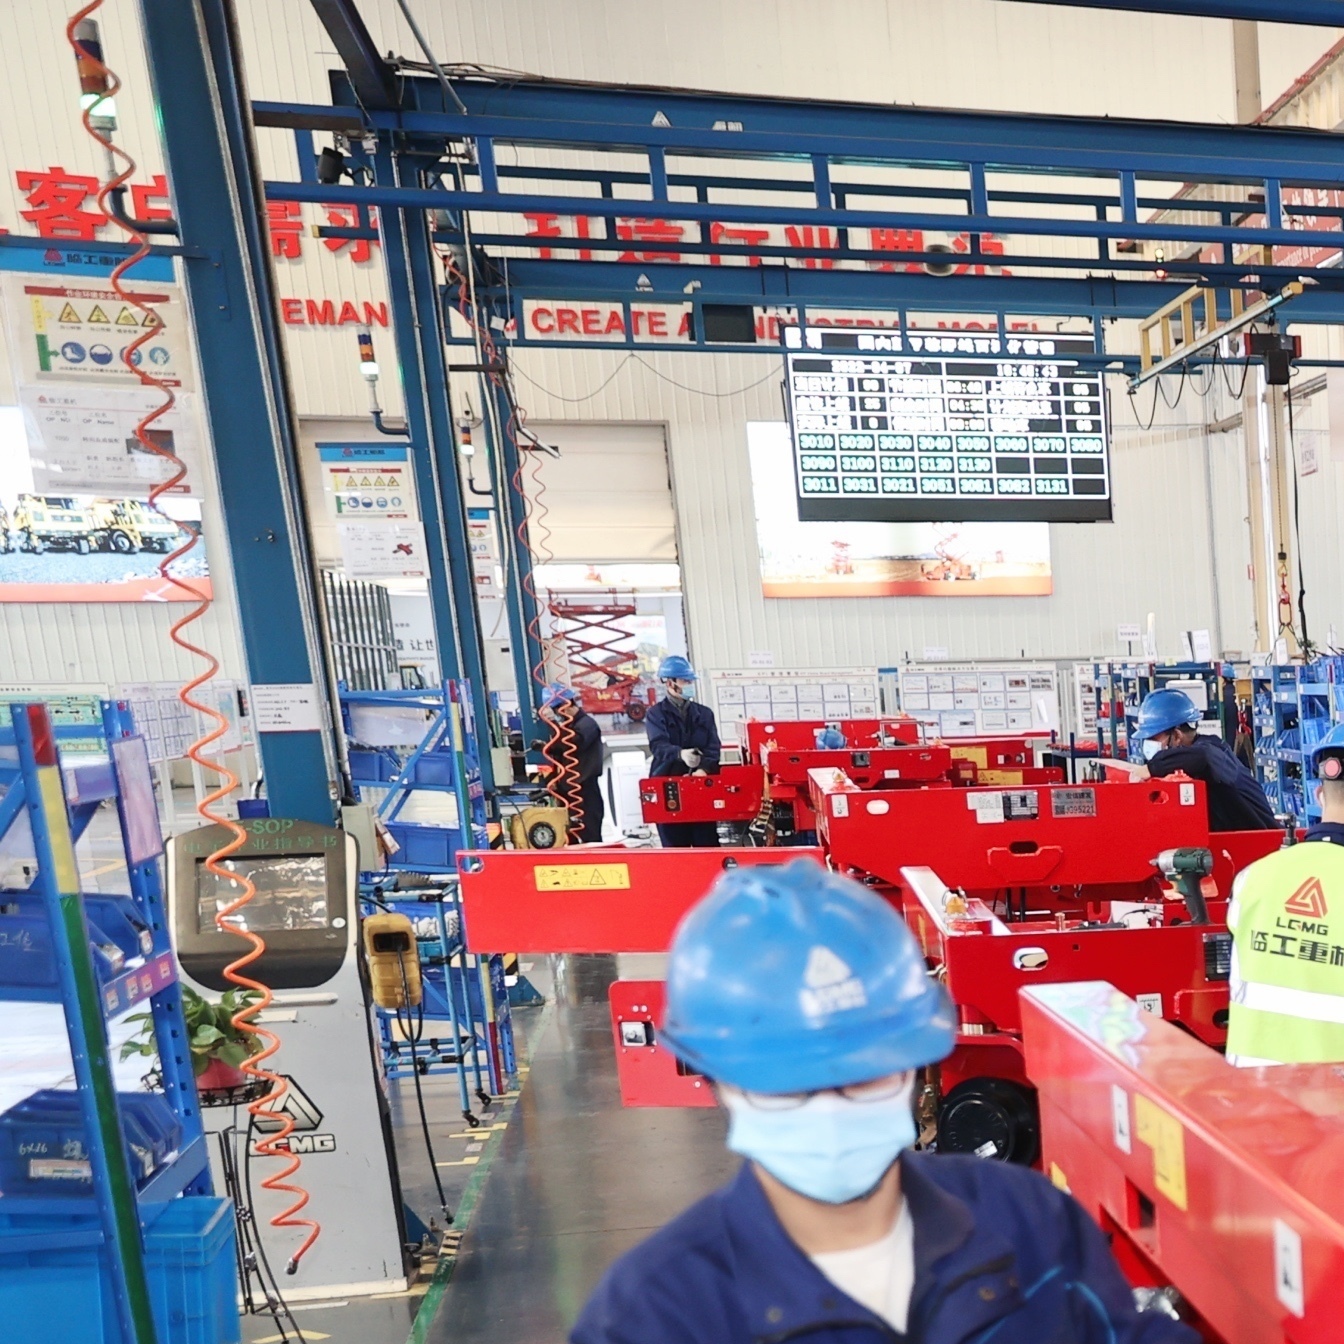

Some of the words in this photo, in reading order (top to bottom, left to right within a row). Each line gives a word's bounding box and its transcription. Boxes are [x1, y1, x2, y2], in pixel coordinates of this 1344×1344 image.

[281, 298, 389, 328] EMAN
[531, 308, 669, 337] CREATE
[800, 434, 834, 449] 3010
[840, 435, 873, 449] 3020
[879, 435, 912, 450] 3030
[918, 436, 951, 451] 3040
[1033, 438, 1065, 452] 3070
[842, 457, 875, 471] 3100
[881, 457, 913, 471] 3110
[920, 458, 952, 471] 3120
[959, 458, 991, 471] 3130
[803, 477, 837, 492] 3011
[843, 478, 876, 492] 3031
[883, 478, 915, 492] 3021
[1036, 479, 1068, 493] 3131
[1276, 917, 1329, 936] LGMG
